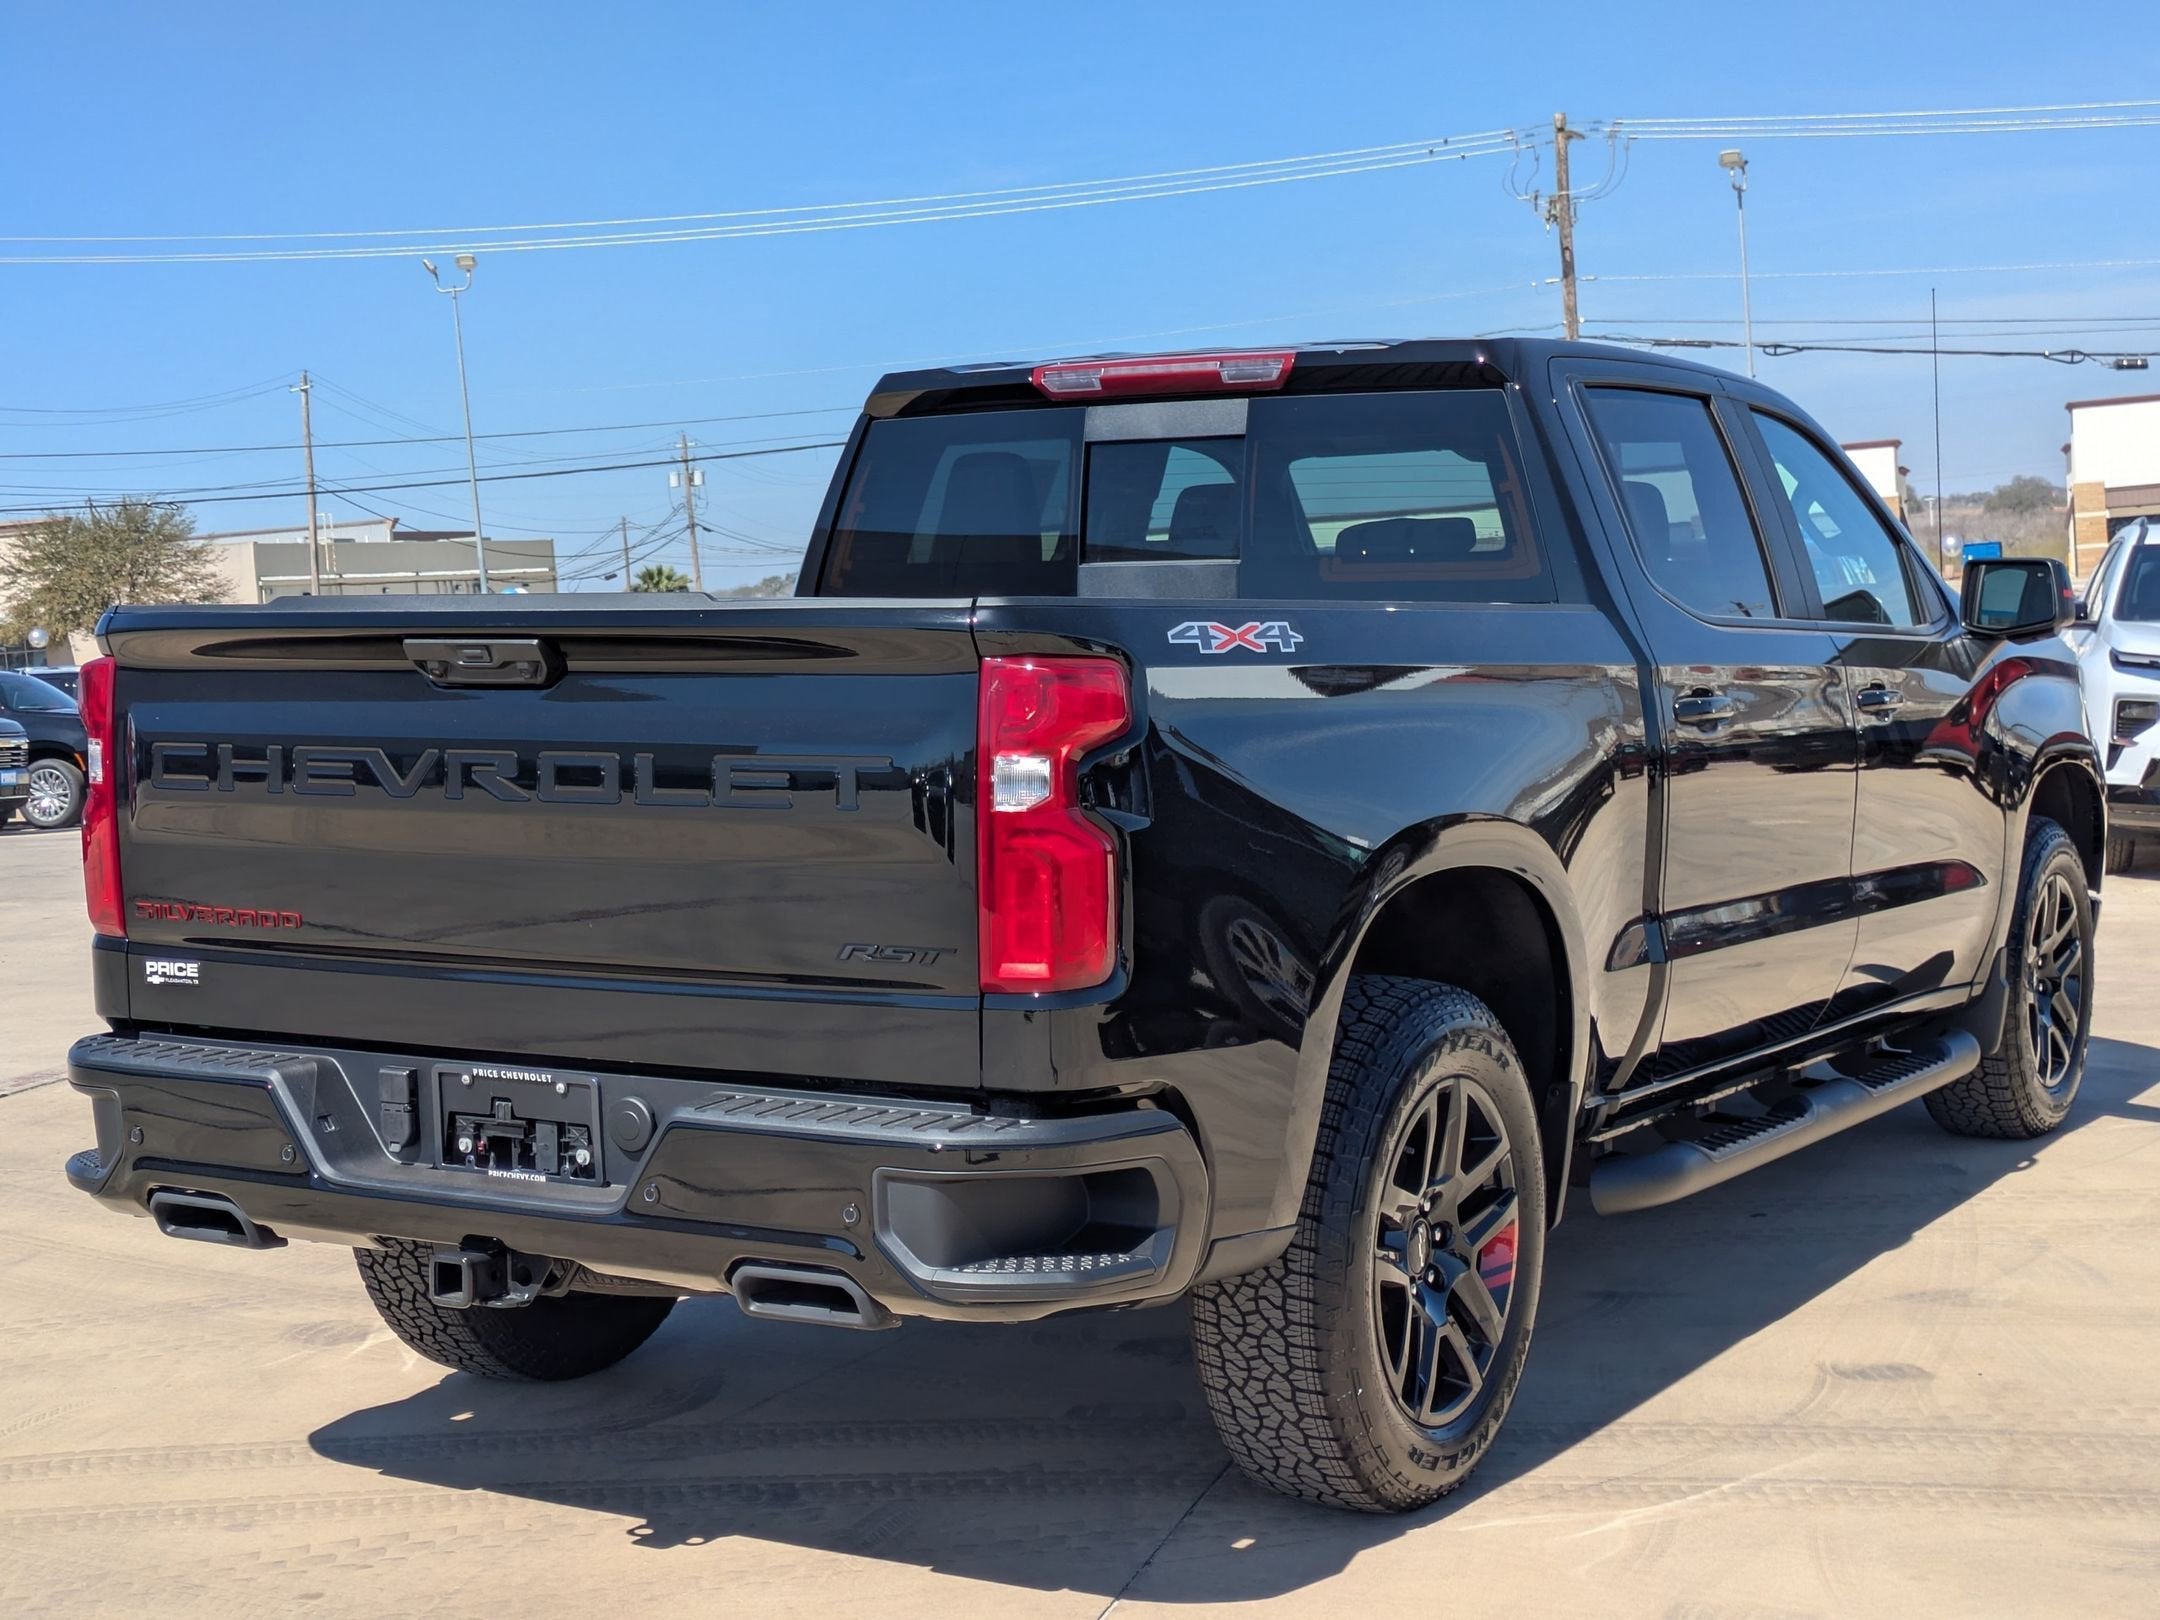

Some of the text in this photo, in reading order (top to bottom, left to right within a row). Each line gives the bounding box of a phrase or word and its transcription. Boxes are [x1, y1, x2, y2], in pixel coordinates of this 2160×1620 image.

[151, 742, 895, 810] CHEVROLET
[135, 901, 303, 929] SILVERADO
[838, 942, 959, 966] RST
[145, 961, 199, 977] PRICE
[472, 1068, 552, 1083] PRICE CHEVROLET
